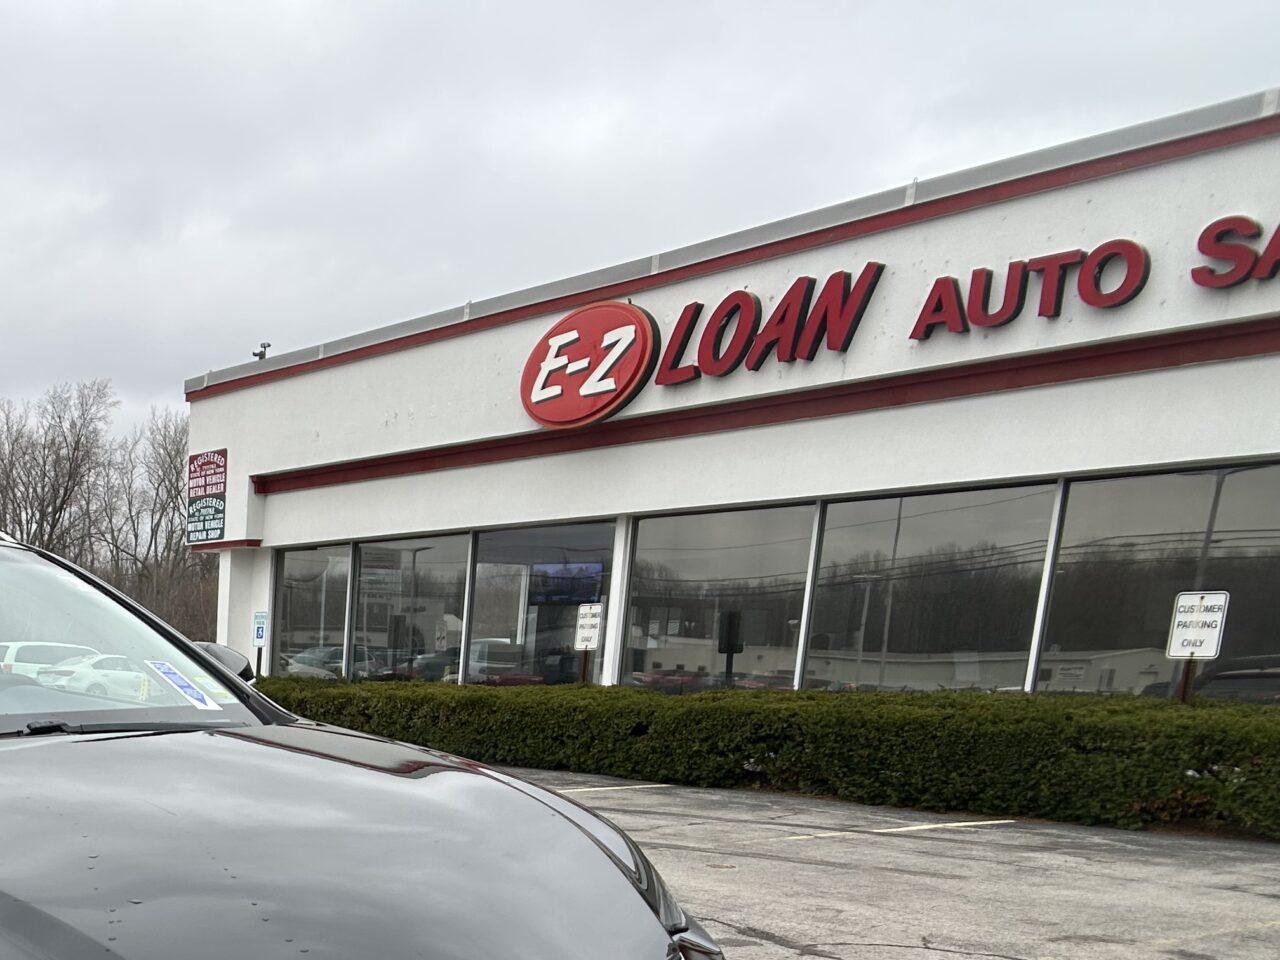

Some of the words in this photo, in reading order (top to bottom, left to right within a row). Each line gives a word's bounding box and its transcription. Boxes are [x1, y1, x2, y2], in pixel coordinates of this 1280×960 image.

[531, 324, 636, 404] E-Z
[655, 261, 886, 386] LOAN
[909, 238, 1152, 340] AUTO
[189, 452, 224, 472] REGISTERED
[189, 477, 205, 488] MOTOR
[206, 472, 225, 485] VEHICLE
[206, 483, 224, 495] DEALER
[189, 497, 224, 514] REGISTERED
[188, 521, 203, 531] MOTOR
[205, 519, 223, 529] VEHICLE
[190, 530, 206, 540] REPAIR
[208, 529, 220, 539] SHOP
[1178, 604, 1224, 613] CUSTOMER
[1177, 620, 1218, 629] PARKING
[1181, 639, 1205, 647] ONLY
